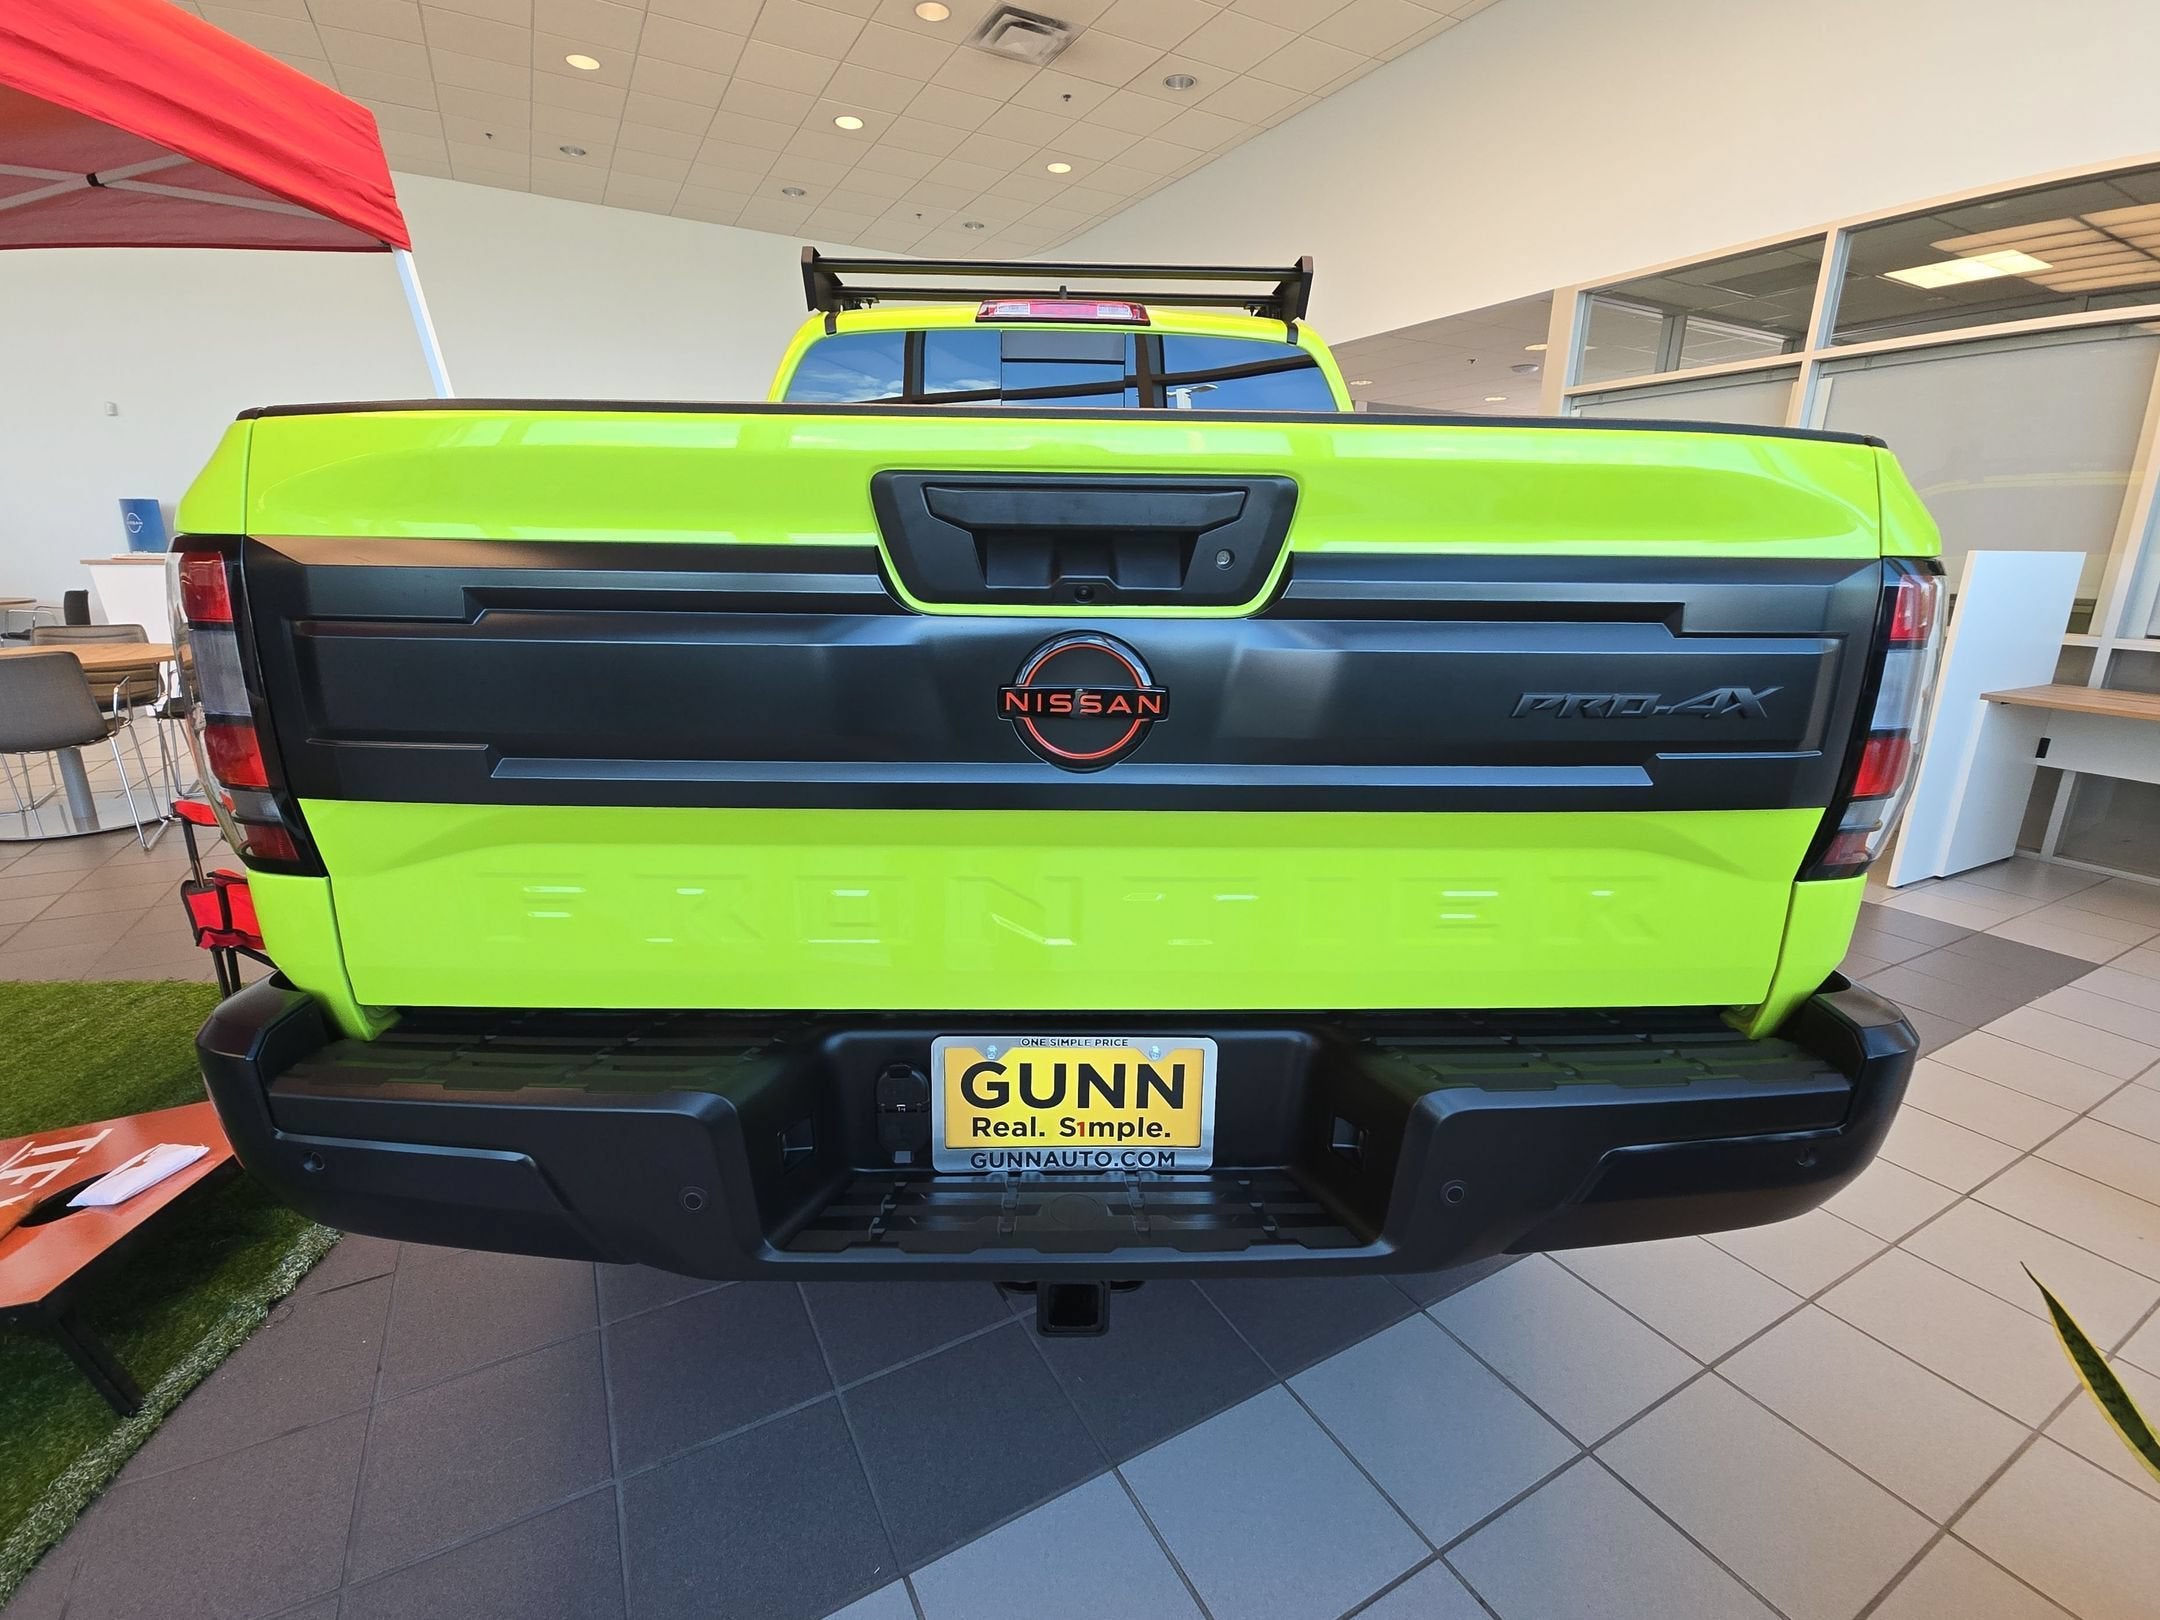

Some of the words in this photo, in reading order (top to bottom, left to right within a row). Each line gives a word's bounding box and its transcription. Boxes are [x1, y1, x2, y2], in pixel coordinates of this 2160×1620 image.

[1005, 691, 1161, 714] NISSAN
[1510, 686, 1785, 718] PRO-4X
[1021, 1038, 1046, 1047] ONE
[1050, 1038, 1092, 1047] SIMPLE
[1094, 1038, 1129, 1047] PRICE
[960, 1061, 1185, 1109] GUNN
[972, 1116, 1046, 1137] Real.
[1059, 1116, 1171, 1141] S1mple.
[970, 1151, 1176, 1168] GUNNAUTO.COM
